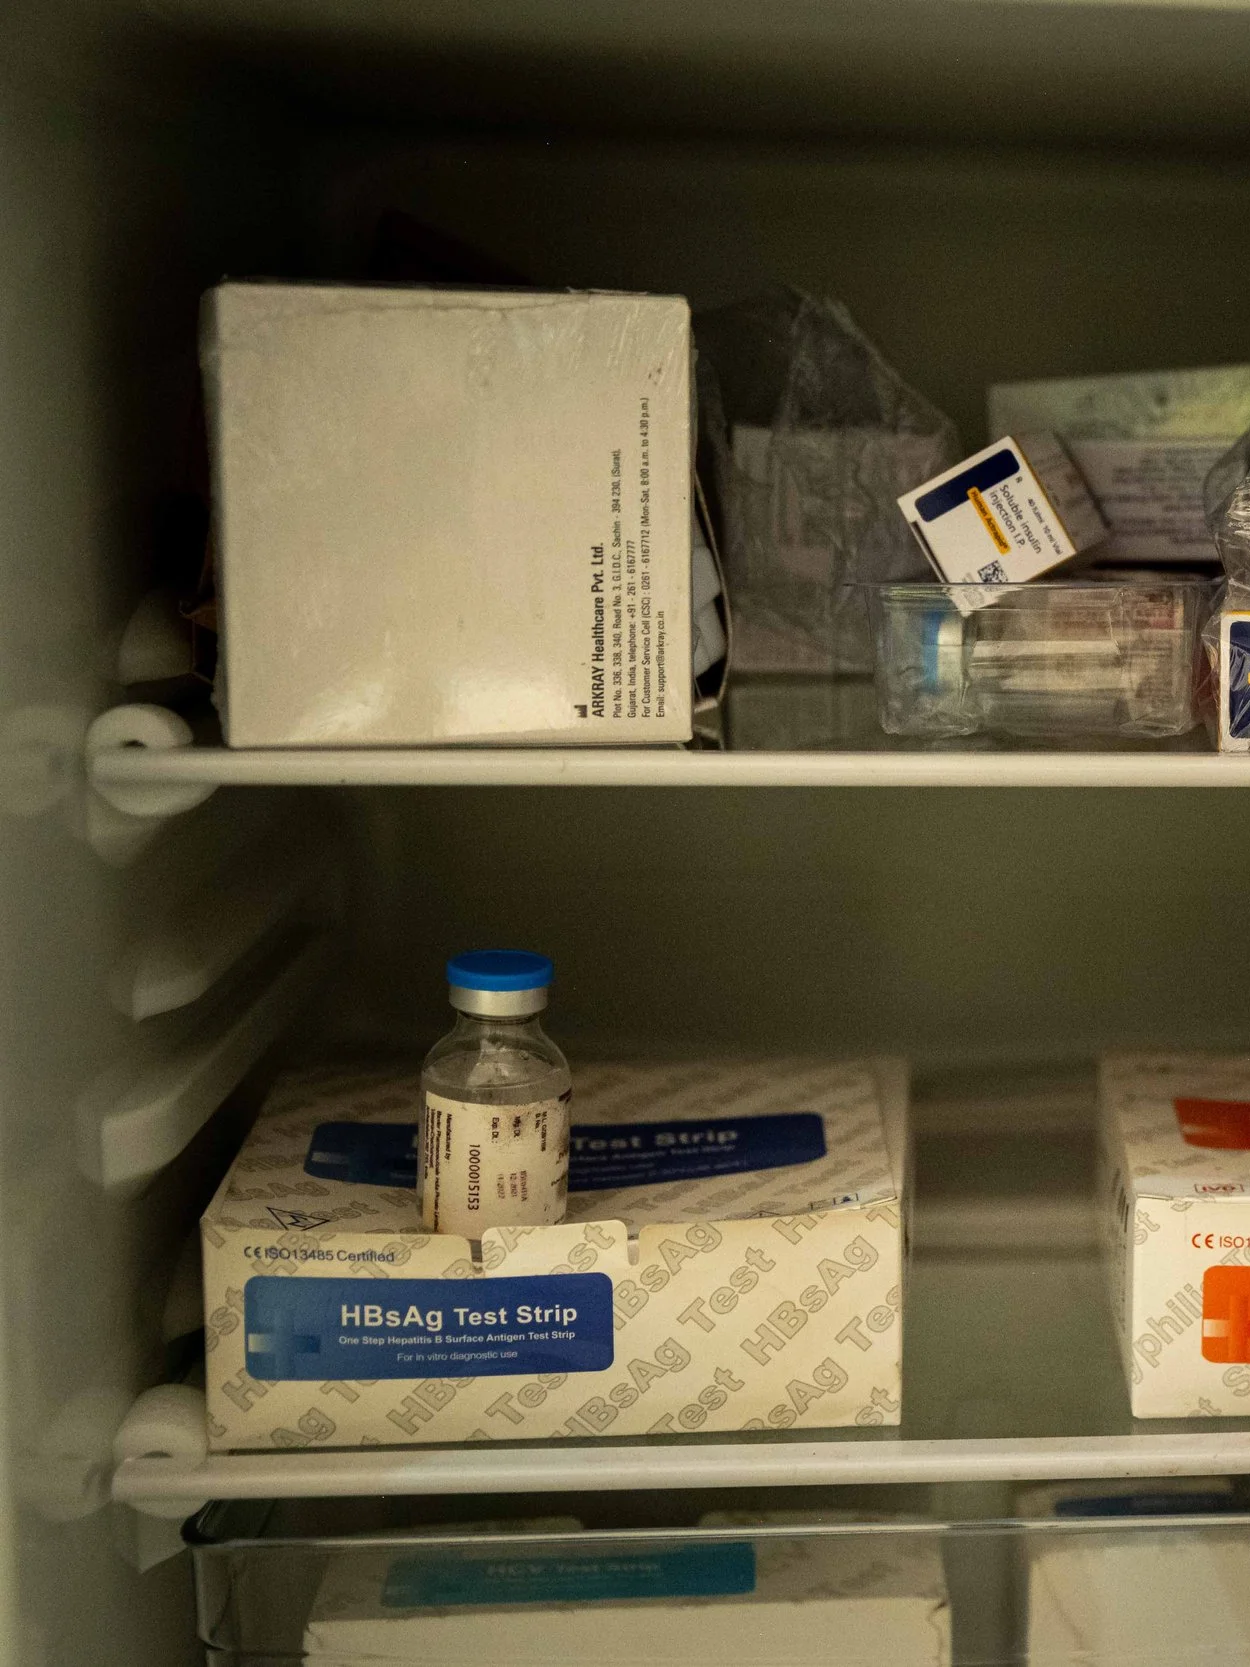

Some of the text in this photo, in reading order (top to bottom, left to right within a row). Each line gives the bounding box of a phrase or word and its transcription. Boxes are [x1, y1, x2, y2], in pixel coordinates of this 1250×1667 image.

[640, 419, 649, 437] 4:30
[640, 439, 649, 447] to
[988, 490, 1017, 534] injection
[999, 484, 1042, 555] Soluble insulin
[641, 530, 650, 564] 6167712
[641, 571, 650, 590] 0261
[642, 597, 651, 619] (CSC)
[591, 542, 604, 718] ARKRAY Healthcare Pvt. Ltd.
[627, 540, 637, 718] Gujarat, India, telephone: +91 261 6167777
[642, 620, 651, 636] Cell
[642, 636, 651, 666] Service
[656, 611, 666, 718] Email: support@arkray.co.in
[642, 667, 651, 704] Customer
[642, 705, 651, 718] For
[468, 1144, 480, 1211] 1000015153
[264, 1247, 334, 1261] ISO13485
[336, 1250, 395, 1263] Certified
[676, 1246, 777, 1333] Test
[739, 1234, 880, 1367] HBsAg
[341, 1304, 578, 1332] HBsAg Test Strip
[339, 1330, 576, 1346] One Step Hepatitis B Surface Antigen Test Strip
[397, 1350, 518, 1362] For in vitro diagnostic use
